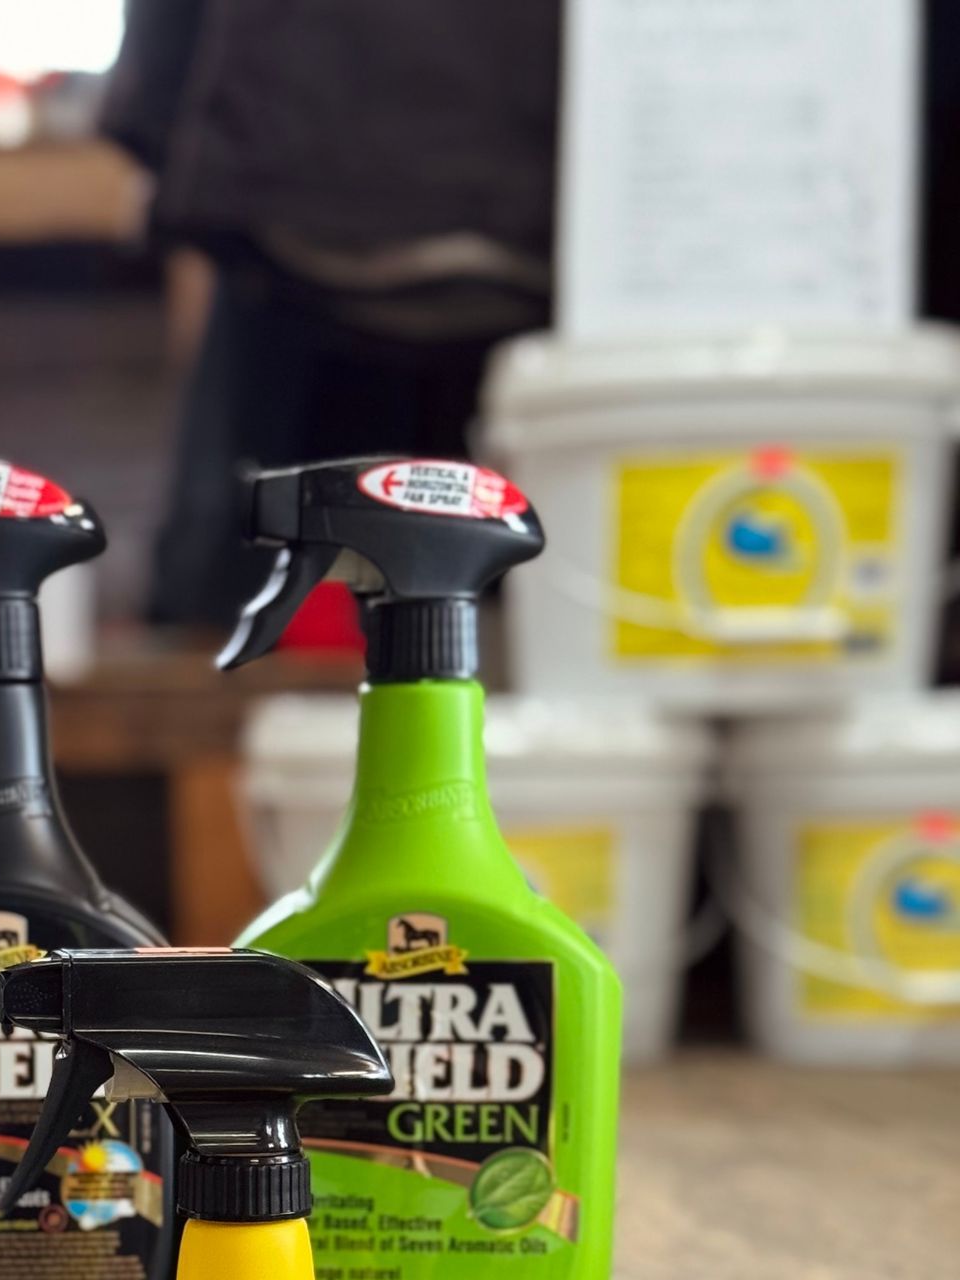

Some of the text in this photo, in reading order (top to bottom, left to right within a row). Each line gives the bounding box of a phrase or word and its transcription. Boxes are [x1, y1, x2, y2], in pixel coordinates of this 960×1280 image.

[429, 493, 463, 506] SPRAY
[333, 978, 536, 1042] LTRA
[387, 1103, 539, 1144] GREEN
[378, 1214, 442, 1231] Effective
[398, 1236, 441, 1251] Seven
[447, 1237, 515, 1253] Aromatic
[518, 1237, 548, 1253] Oils
